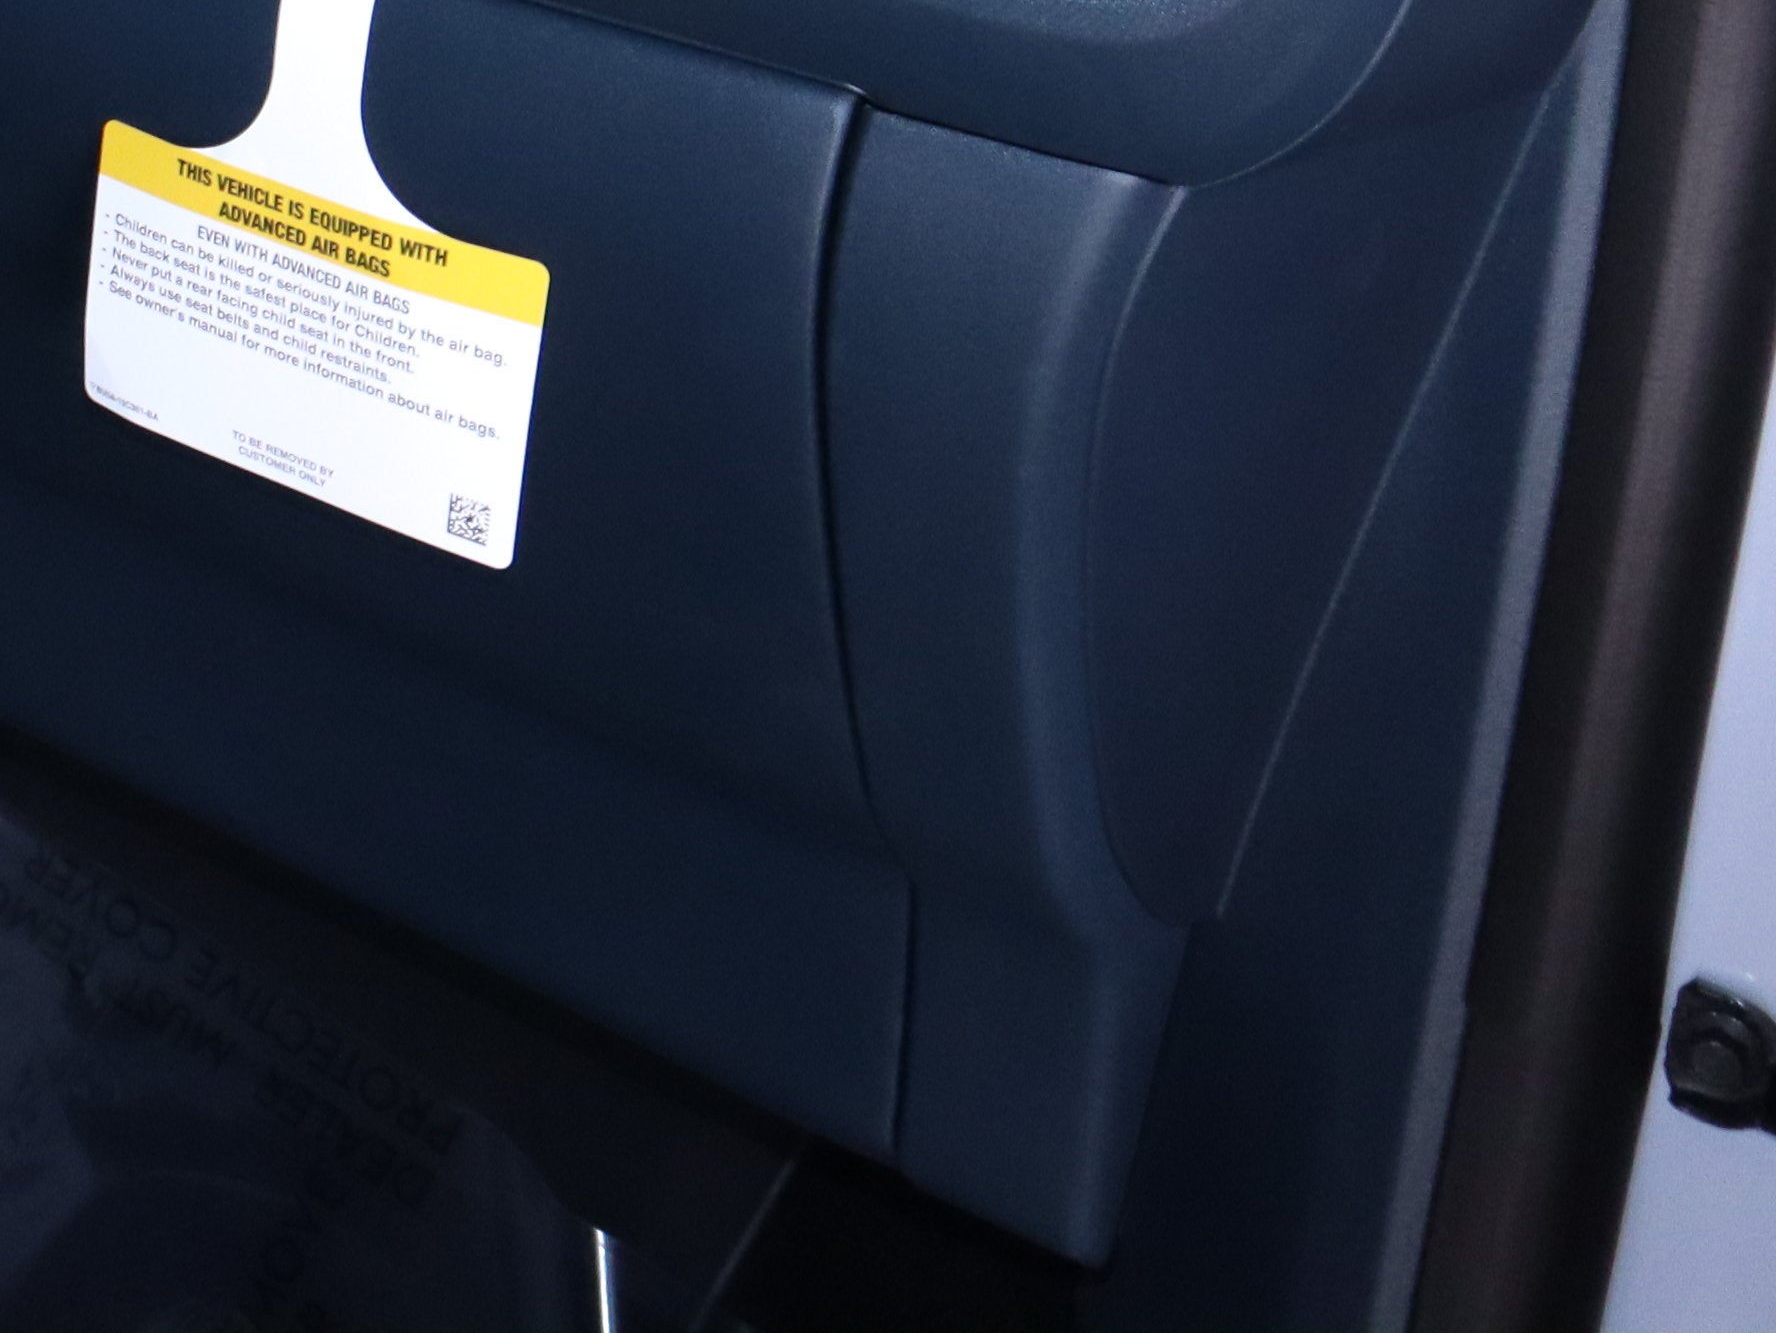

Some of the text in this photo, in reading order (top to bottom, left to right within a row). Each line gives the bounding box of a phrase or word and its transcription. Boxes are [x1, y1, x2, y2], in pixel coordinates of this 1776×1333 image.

[178, 158, 448, 266] THIS VEHICLE IS EQUIPPED WITH
[219, 202, 390, 277] ADVANCED AIR BAGS
[110, 264, 155, 292] Always
[159, 287, 182, 303] use
[186, 298, 212, 316] seat
[217, 307, 249, 329] belts
[253, 324, 278, 341] and
[283, 335, 317, 355] child
[112, 247, 148, 270] Never
[151, 266, 172, 282] put
[175, 276, 183, 286] a
[187, 280, 212, 297] rear
[217, 289, 258, 318] facing
[262, 310, 296, 329] child
[300, 324, 328, 342] seat
[333, 333, 345, 348] in
[349, 341, 371, 358] the
[114, 229, 136, 249] The
[140, 241, 170, 263] back
[174, 257, 200, 276] seat
[204, 266, 215, 281] is
[220, 273, 240, 291] the
[245, 285, 286, 308] safest
[290, 302, 327, 323] place
[332, 311, 350, 331] for
[115, 213, 167, 244] Children
[171, 239, 194, 255] can
[198, 247, 214, 263] be
[218, 254, 254, 277] killed
[258, 272, 273, 283] or
[277, 279, 340, 312] seriously
[344, 301, 394, 330] injured
[398, 321, 416, 339] by
[421, 329, 444, 346] the
[449, 340, 469, 353] air
[198, 225, 409, 314] EVEN WITH ADVANCED AIR BAGS
[109, 280, 132, 300] See
[135, 294, 185, 322] owner's
[189, 316, 237, 342] manual
[242, 334, 260, 351] for
[264, 345, 299, 366] more
[304, 358, 383, 398] information
[388, 393, 430, 416] about
[435, 410, 454, 423] air
[233, 430, 246, 442] TO
[266, 444, 316, 471] REMOVED
[320, 466, 334, 477] BY
[238, 446, 325, 487] CUSTOMER ONLY
[182, 943, 465, 1157] PROTECTIVE
